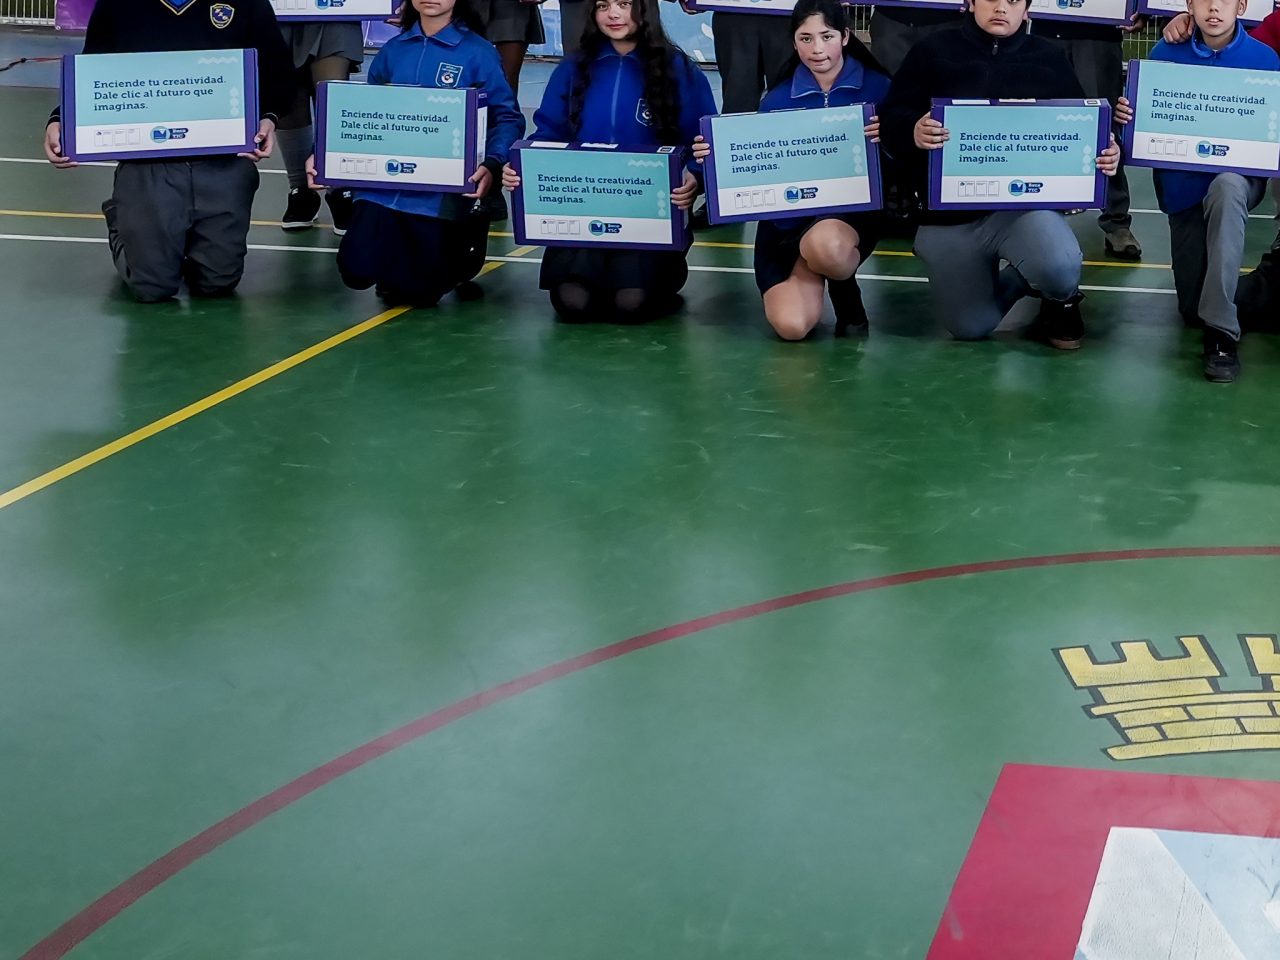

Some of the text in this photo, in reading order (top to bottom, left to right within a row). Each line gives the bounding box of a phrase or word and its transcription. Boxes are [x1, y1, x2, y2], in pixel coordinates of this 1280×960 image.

[93, 79, 145, 89] Enciende
[162, 76, 226, 86] creatividad.
[94, 89, 214, 100] Dale clic al futuro que
[1152, 88, 1197, 100] Enciende
[94, 102, 148, 112] imaginas.
[1152, 99, 1255, 116] Dale clic al futuro que
[341, 109, 383, 120] Enciende
[385, 112, 395, 120] tu
[341, 120, 361, 129] Dale
[363, 122, 379, 130] clic
[391, 123, 420, 132] futuro
[729, 133, 849, 151] Enciende tu creatividad.
[960, 132, 1007, 141] Enciende
[960, 143, 982, 152] Dale
[984, 144, 1002, 152] clic
[731, 147, 838, 162] Dale clic al futuro que
[959, 154, 1008, 164] imaginas.
[732, 163, 780, 174] imaginas.
[537, 174, 582, 183] Enciende
[538, 184, 560, 192] Dale
[562, 185, 579, 193] clic
[592, 186, 623, 194] futuro
